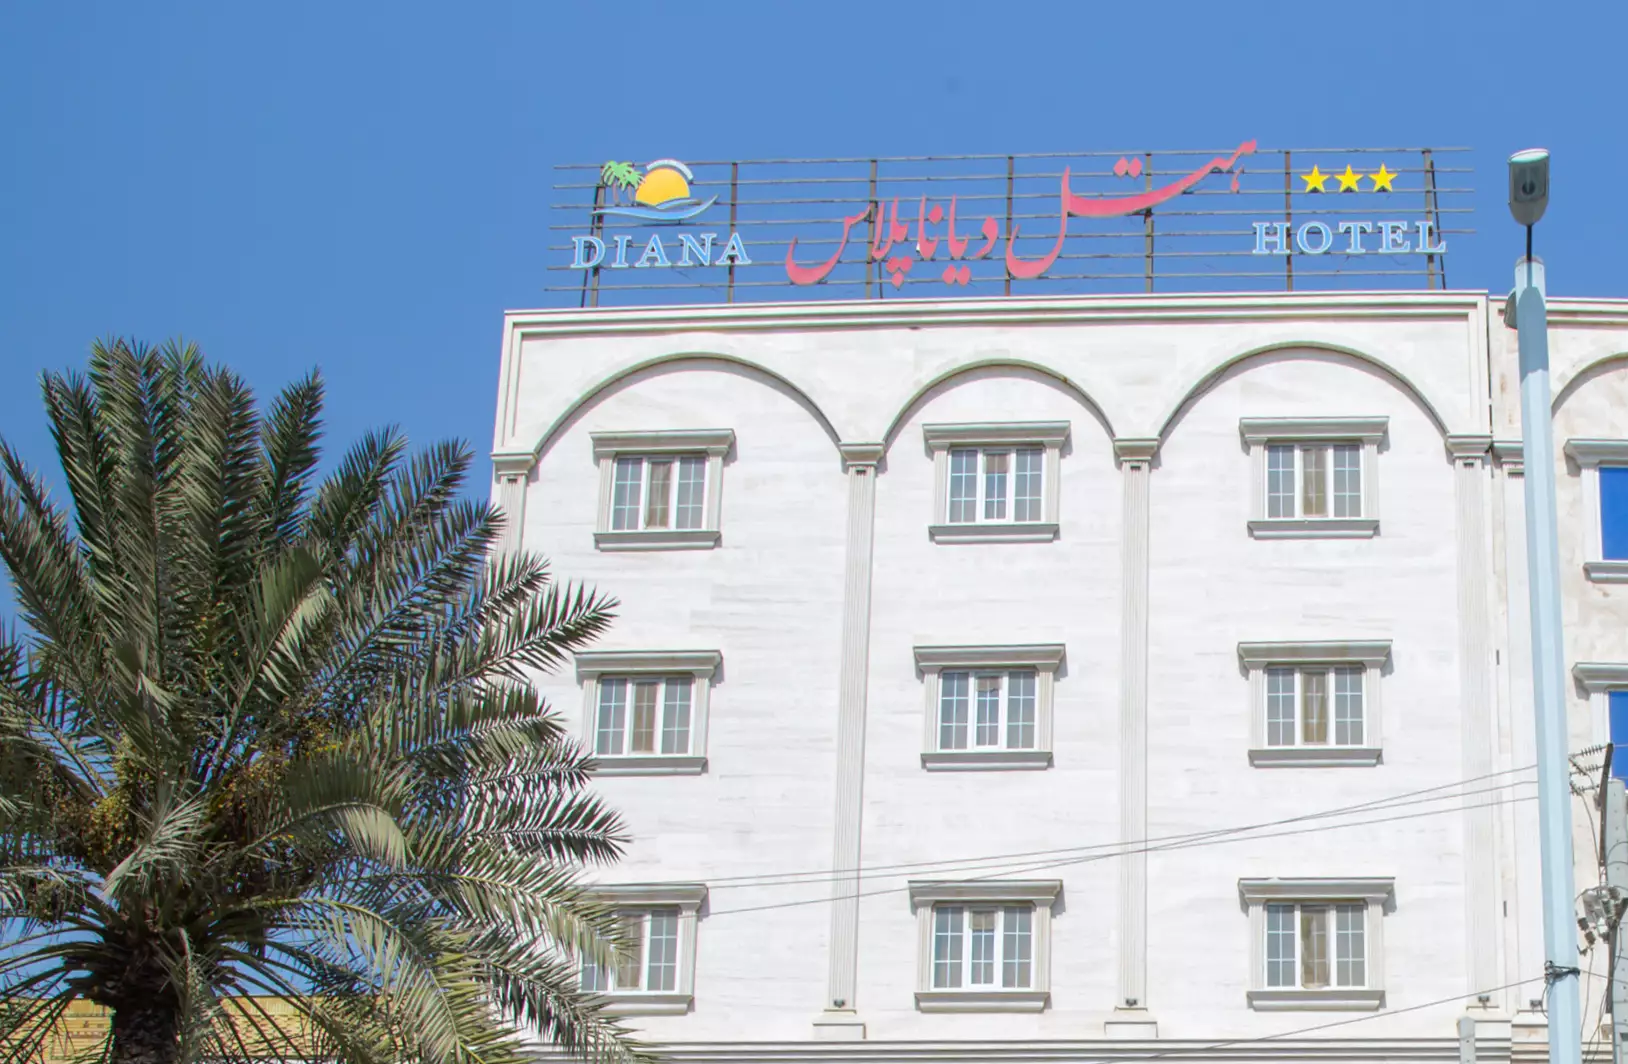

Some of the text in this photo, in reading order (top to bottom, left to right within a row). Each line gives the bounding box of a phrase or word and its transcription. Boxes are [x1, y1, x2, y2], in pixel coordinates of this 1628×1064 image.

[785, 138, 1258, 288] هتل دیانا پلاس
[570, 232, 752, 269] DIANA
[1252, 220, 1447, 255] HOTEL
